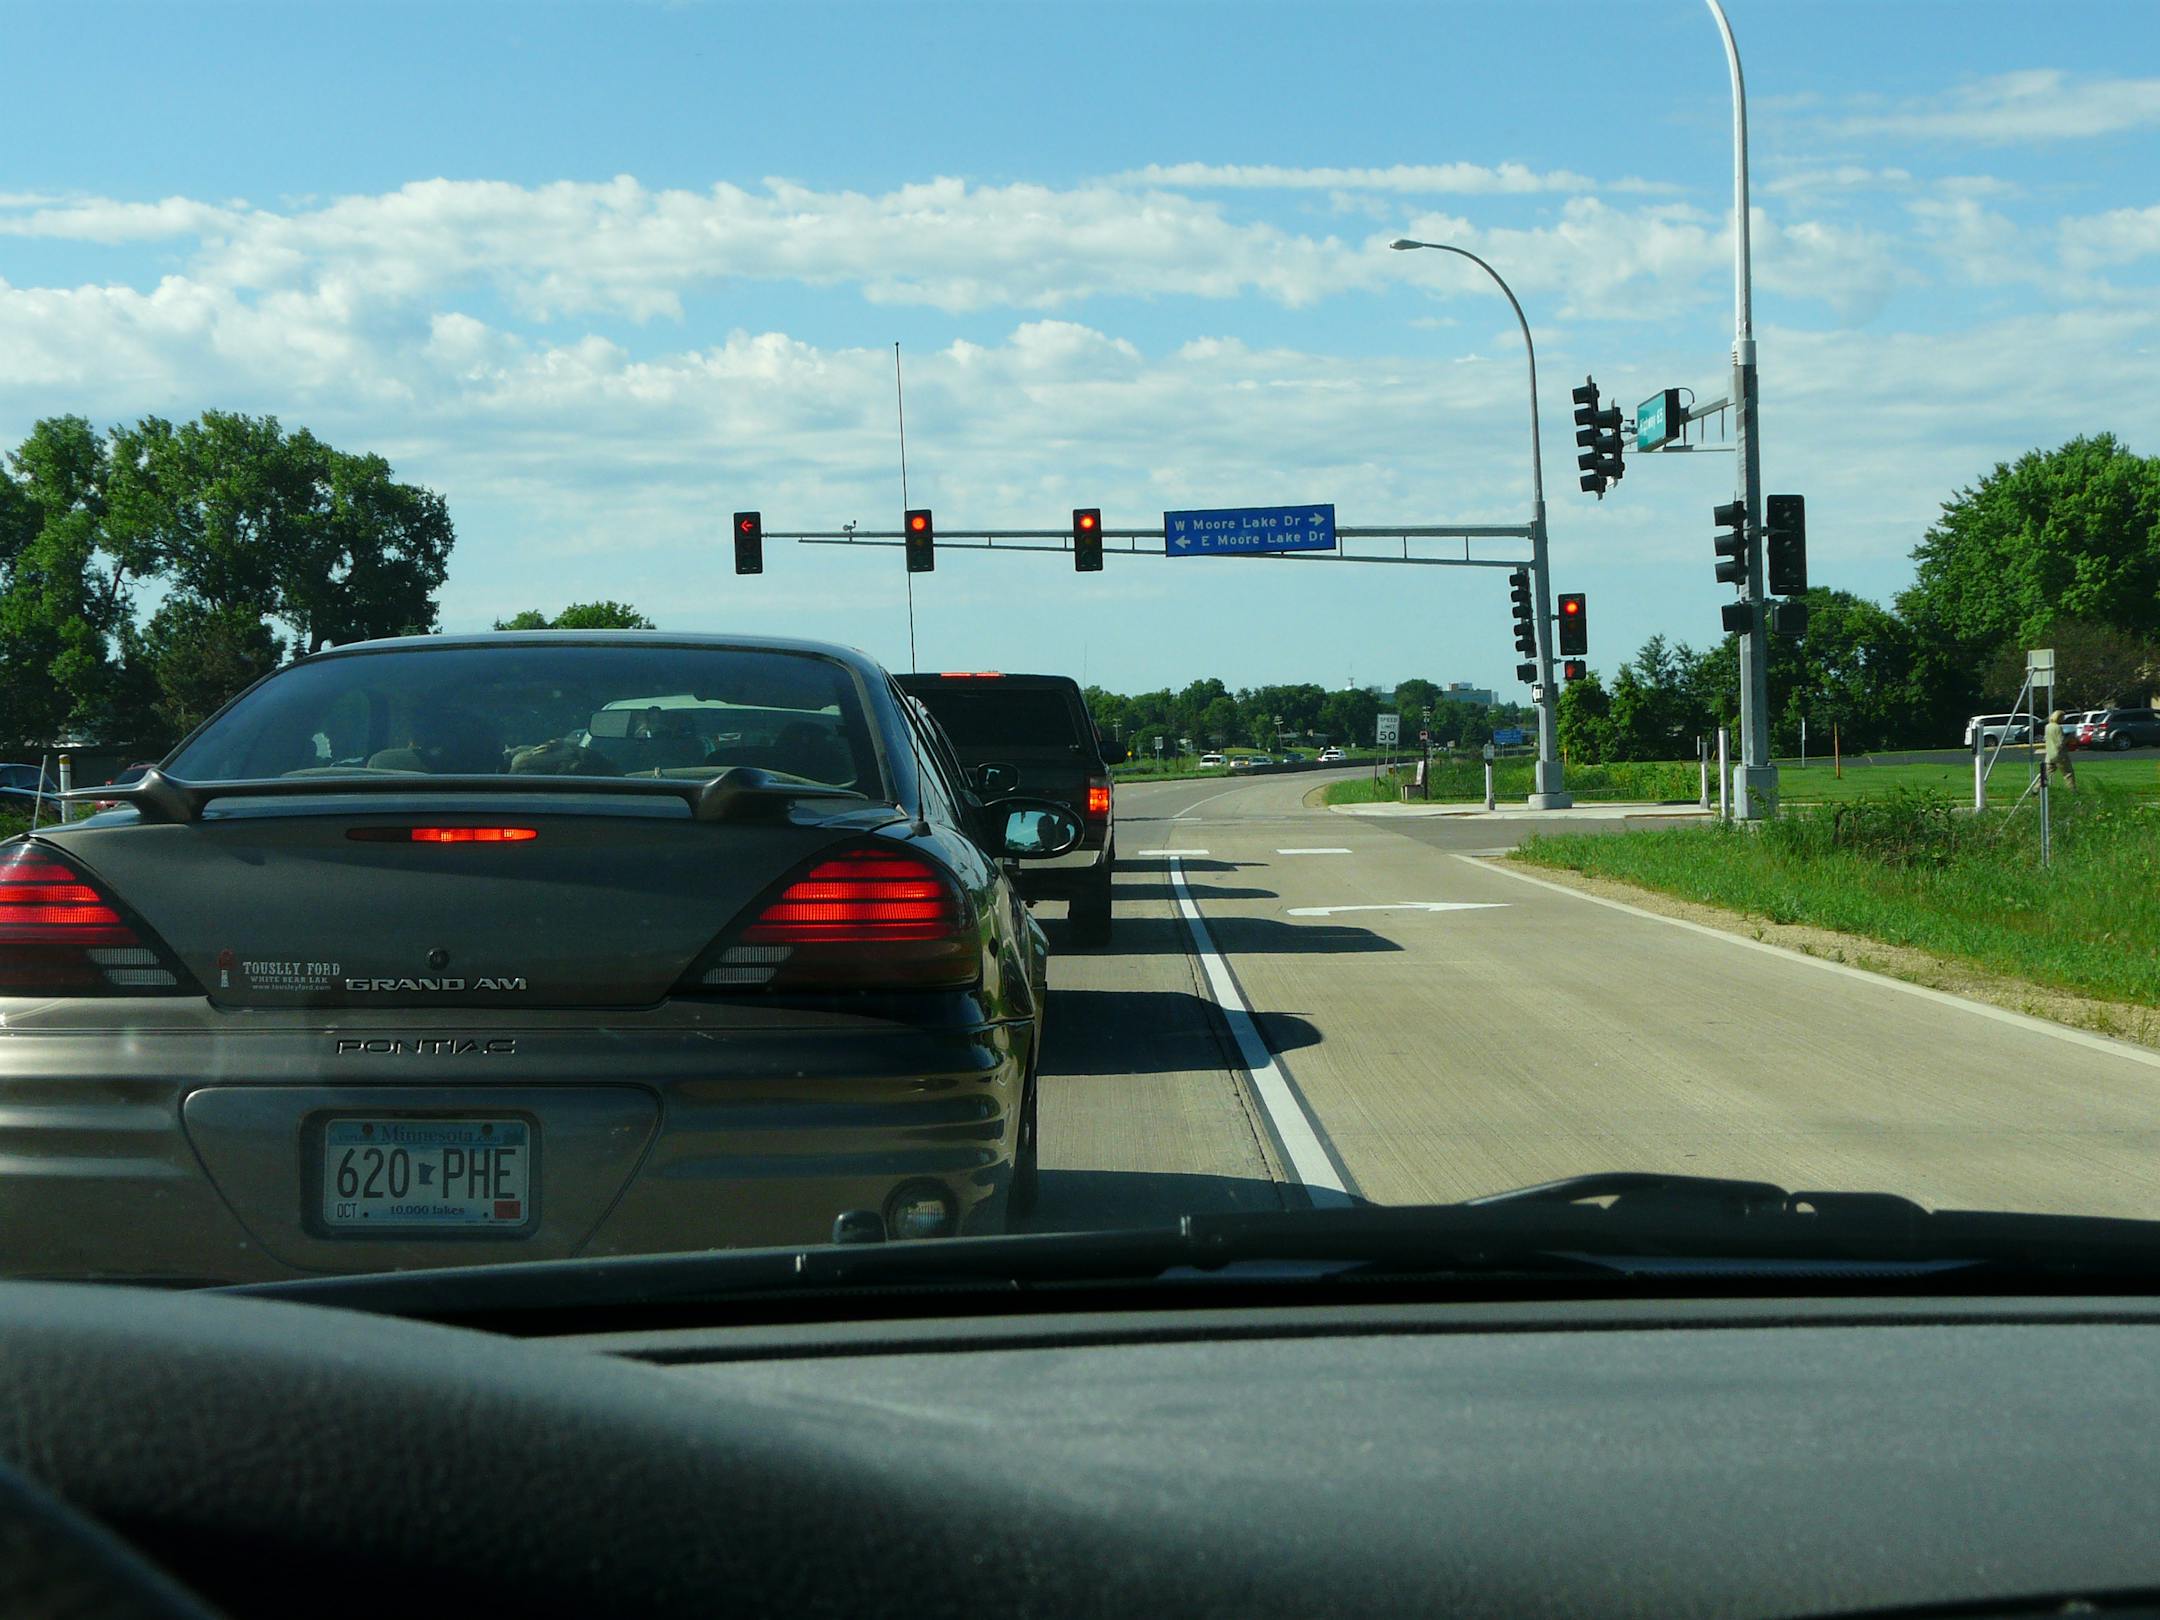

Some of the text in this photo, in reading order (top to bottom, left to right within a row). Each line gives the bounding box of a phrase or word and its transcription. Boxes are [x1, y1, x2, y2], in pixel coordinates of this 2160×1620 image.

[1175, 515, 1300, 531] W Moore Lake Dr
[1201, 531, 1325, 547] E Moore Lake Dr
[1379, 731, 1396, 741] 50
[306, 962, 341, 976] FORD
[250, 975, 280, 983] WHITE
[345, 977, 527, 991] GRAND AM
[336, 1039, 516, 1055] PONTIAC
[380, 1125, 472, 1142] Minnesota
[337, 1147, 516, 1199] 620 PHE
[337, 1203, 357, 1218] OCT
[390, 1205, 465, 1217] 10,000 lakes
